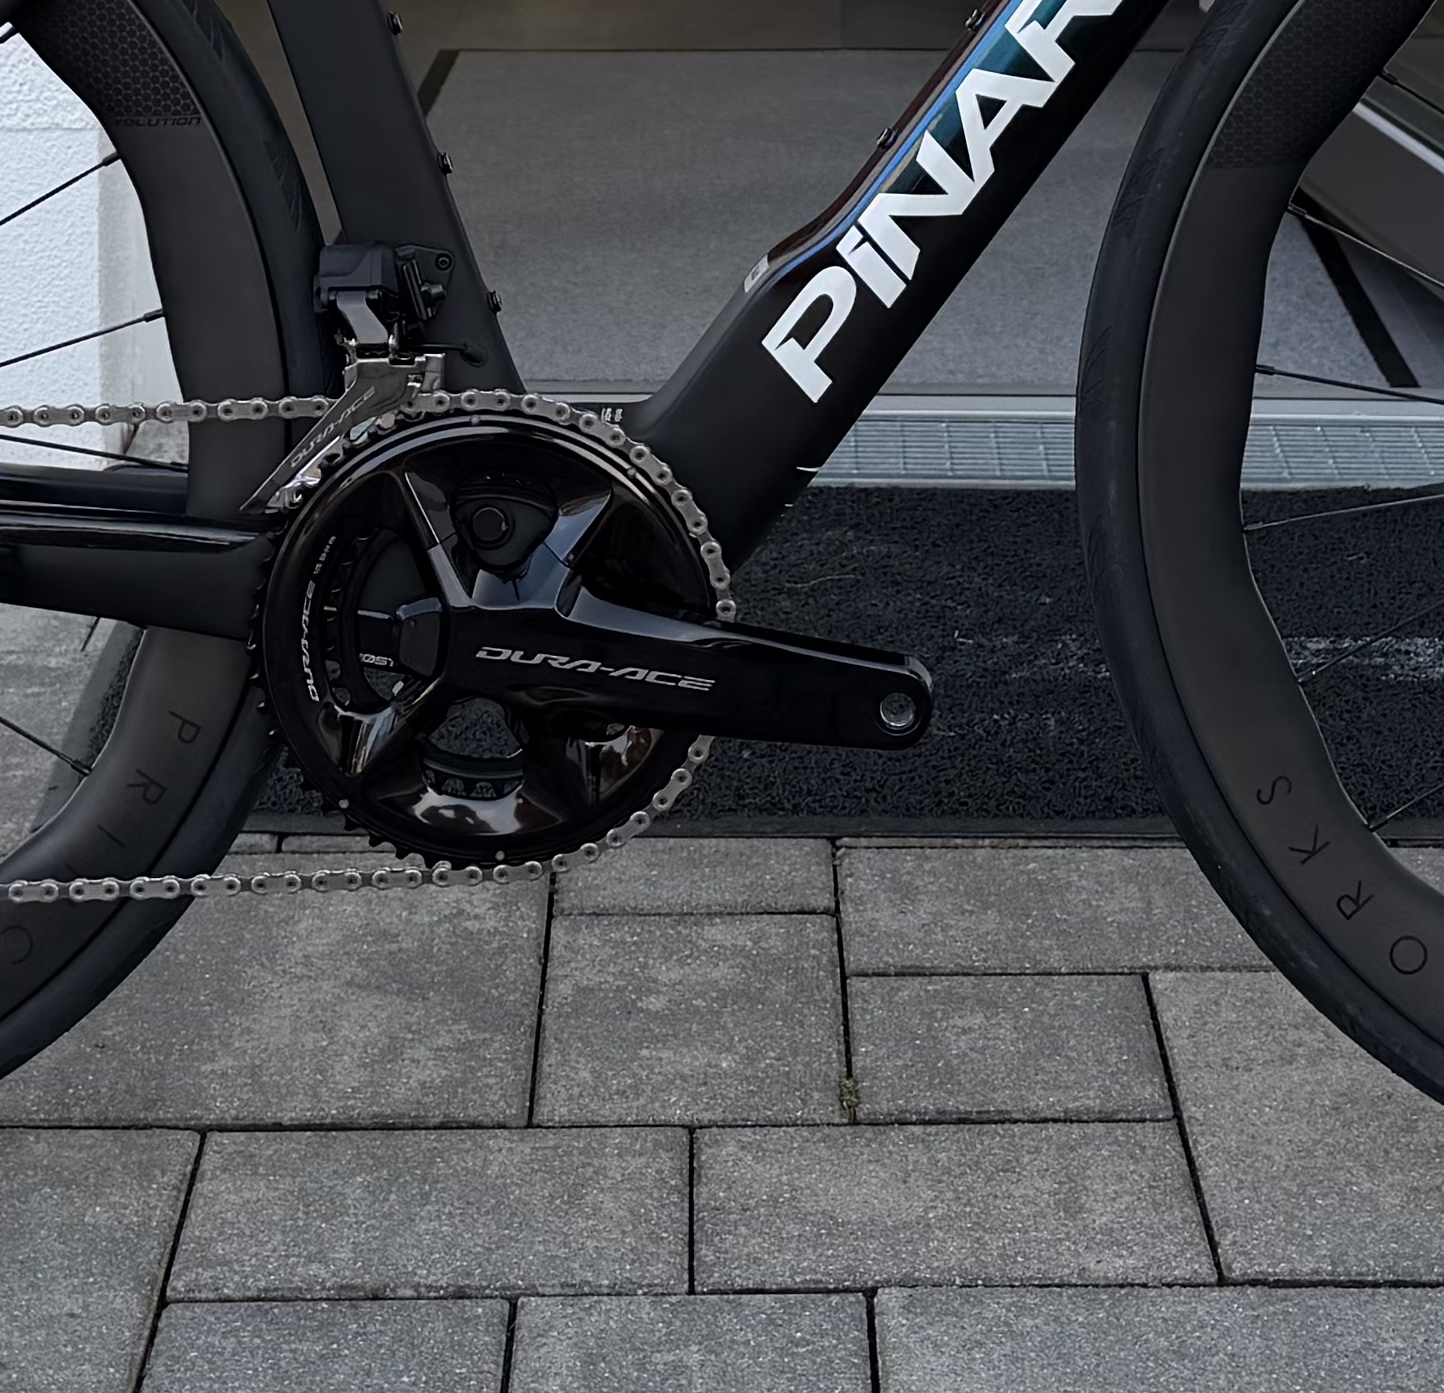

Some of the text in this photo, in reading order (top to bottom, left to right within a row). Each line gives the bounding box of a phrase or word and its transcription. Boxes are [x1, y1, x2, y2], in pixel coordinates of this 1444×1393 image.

[290, 385, 377, 469] DURA-ACE
[300, 578, 322, 703] DURA-ACE
[475, 645, 716, 692] DURA-ACE
